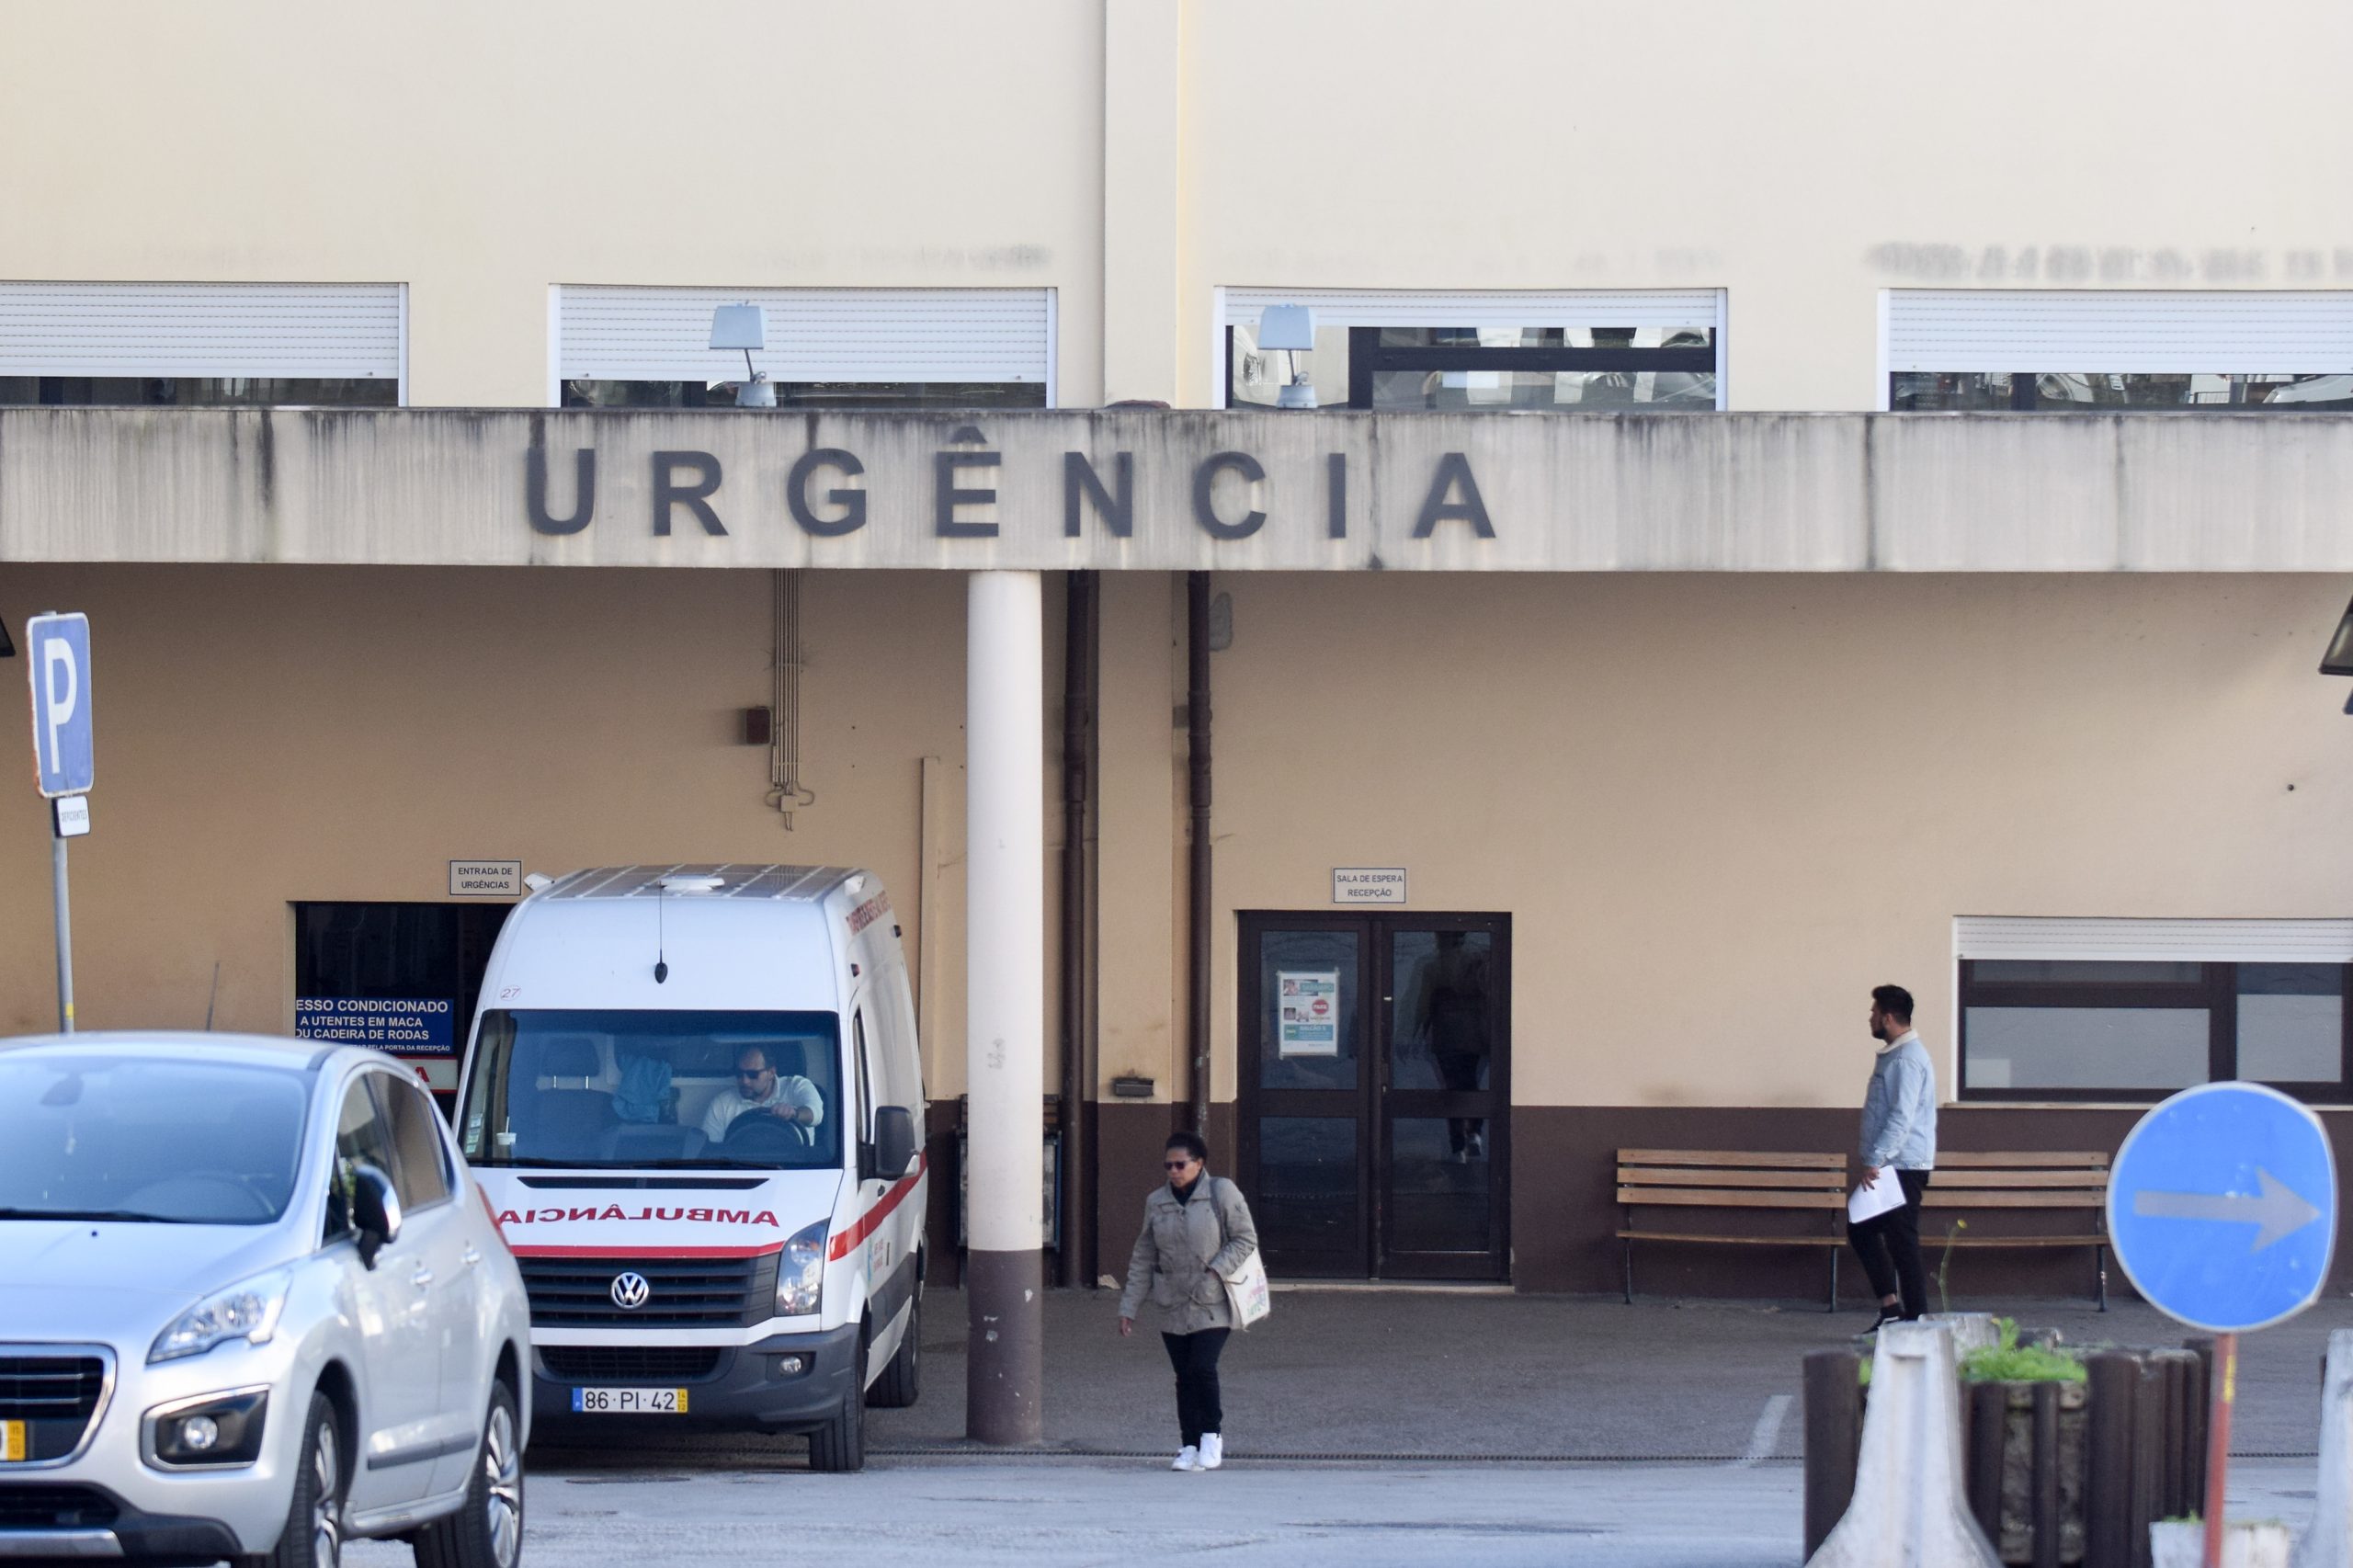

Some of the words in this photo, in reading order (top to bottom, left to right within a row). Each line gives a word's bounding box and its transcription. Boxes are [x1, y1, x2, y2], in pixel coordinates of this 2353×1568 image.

[527, 426, 1496, 539] URGÊNCIA
[44, 638, 77, 774] P
[461, 880, 509, 889] URGÊNCIAS
[1347, 888, 1392, 897] RECEPÇÃO
[500, 988, 520, 998] 27
[337, 1000, 448, 1013] CONDICIONADO
[301, 1017, 309, 1026] A
[312, 1017, 365, 1026] UTENTES
[369, 1017, 385, 1027] EM
[388, 1017, 423, 1028] MACA
[296, 1028, 311, 1038] OU
[313, 1029, 366, 1039] CADEIRA
[369, 1029, 384, 1040] DE
[388, 1030, 429, 1040] RODAS
[416, 1044, 450, 1052] RECEPÇÃO
